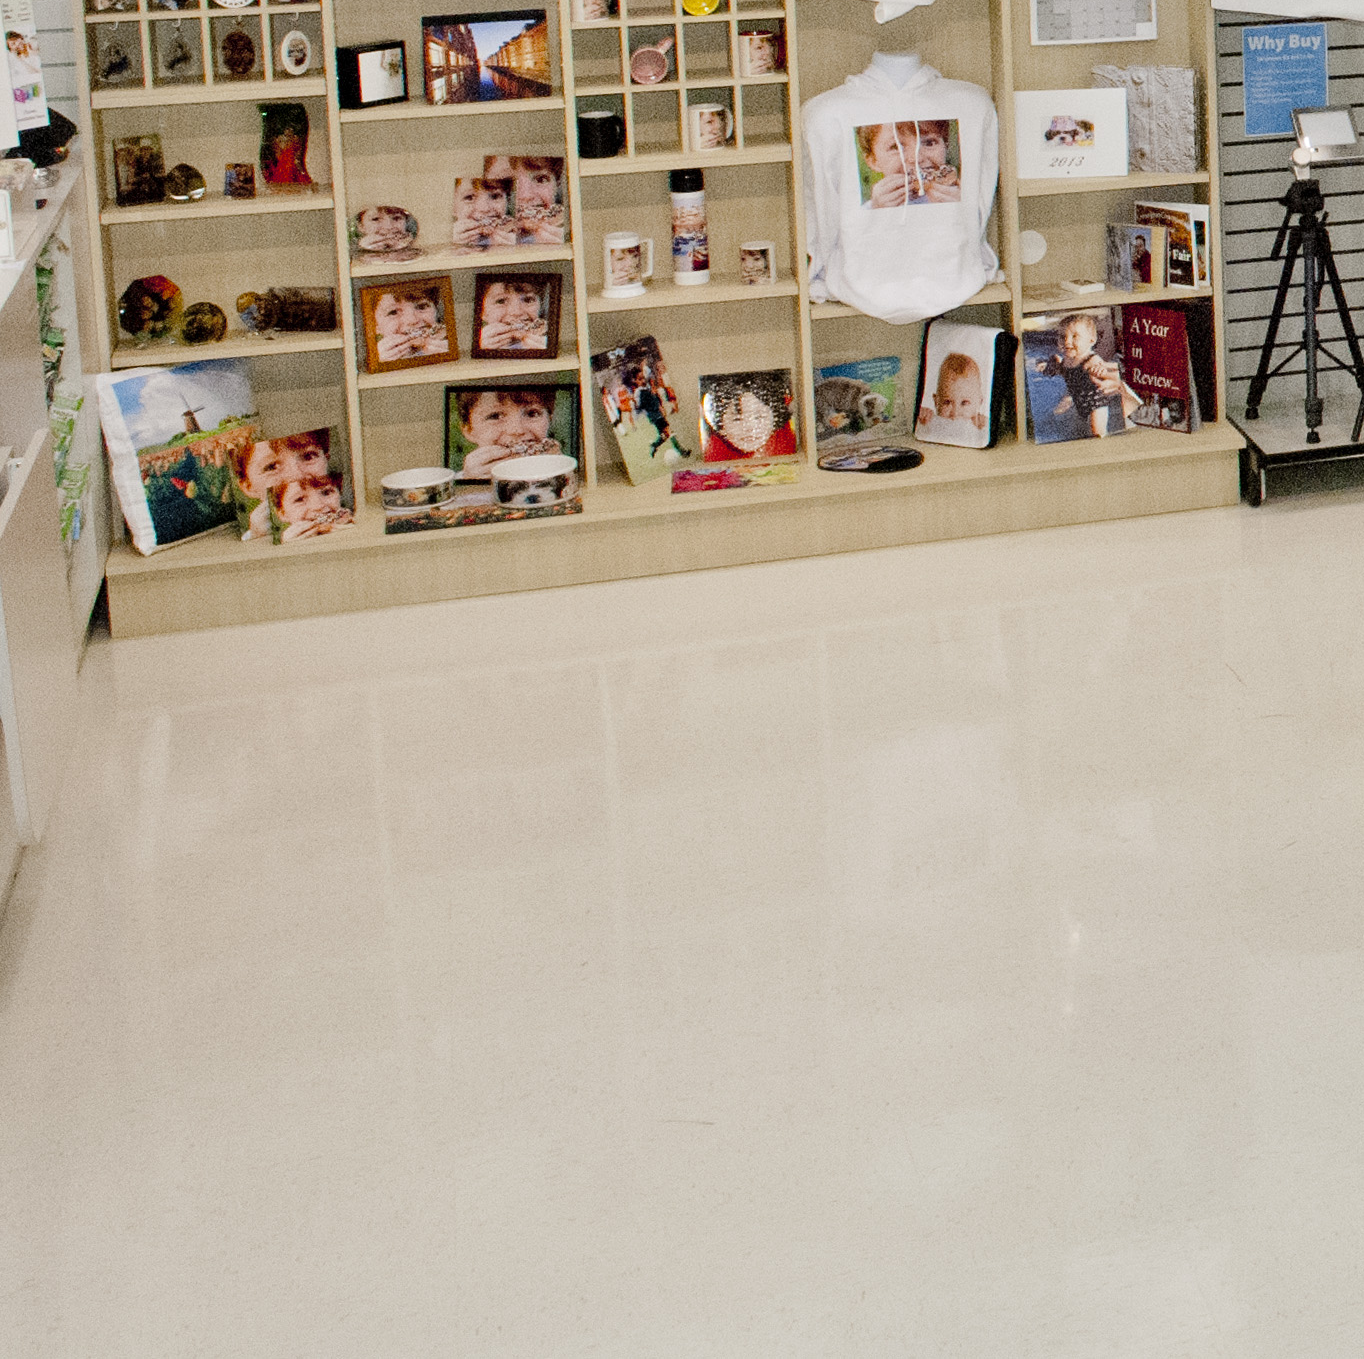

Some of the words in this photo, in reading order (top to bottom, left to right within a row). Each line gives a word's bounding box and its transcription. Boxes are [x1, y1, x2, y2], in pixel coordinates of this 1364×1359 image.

[1247, 36, 1286, 52] Why
[1288, 34, 1322, 50] Buy
[1048, 155, 1086, 168] 2013
[1130, 317, 1141, 334] A
[1141, 319, 1170, 338] Year
[1131, 344, 1143, 360] in
